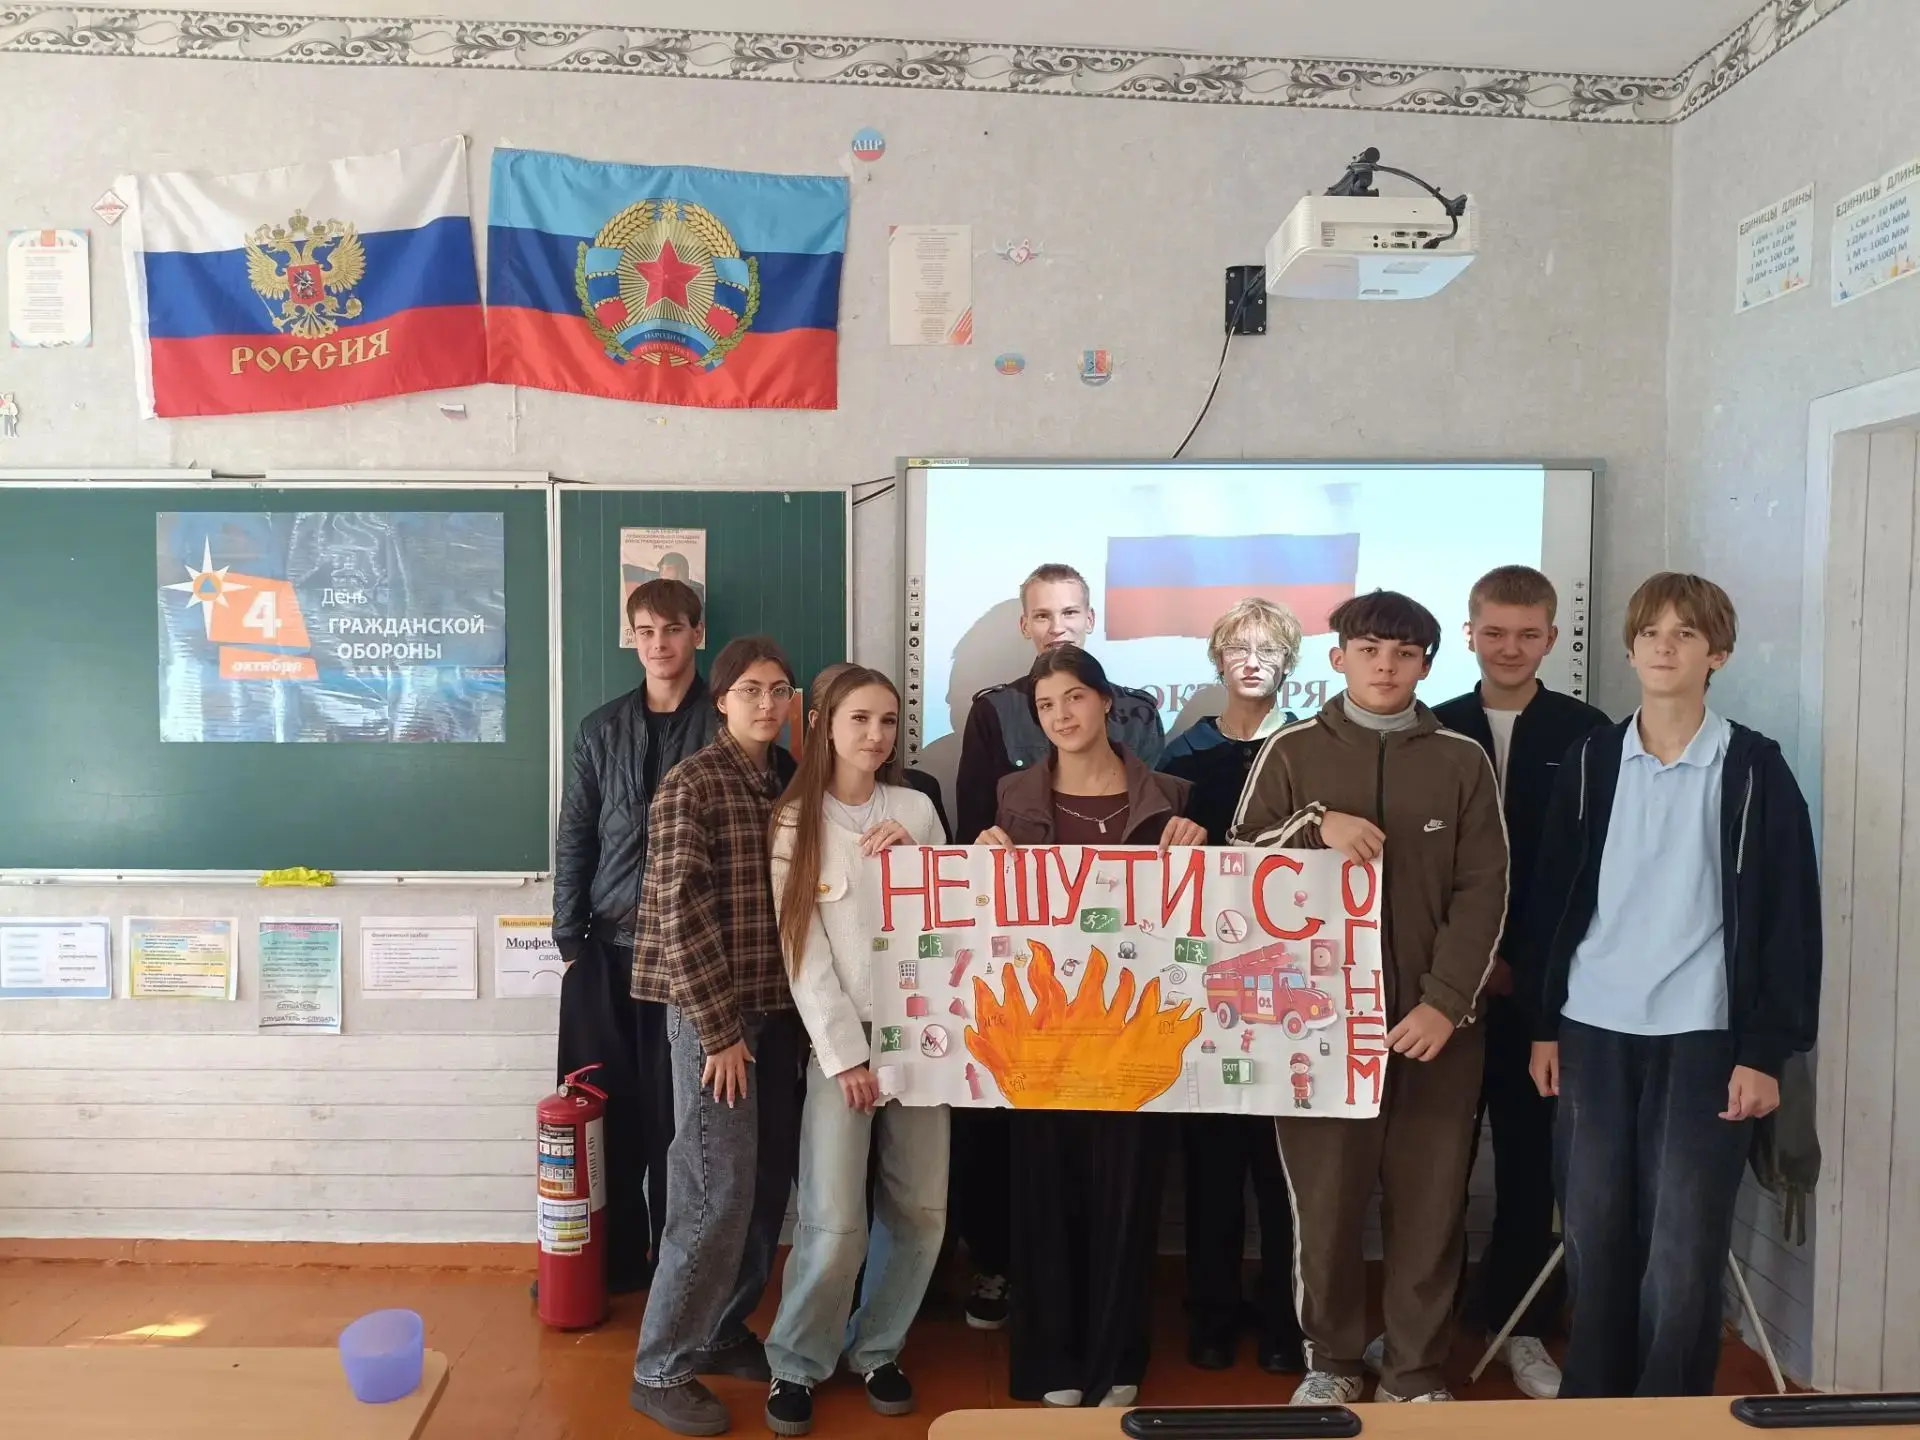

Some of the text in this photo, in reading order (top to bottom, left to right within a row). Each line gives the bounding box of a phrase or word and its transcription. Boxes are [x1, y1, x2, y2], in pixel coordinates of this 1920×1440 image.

[1836, 185, 1880, 217] ЕДИНИЦЫ
[1739, 189, 1812, 236] ЕДИНИЦЫ ДЛИНЫ
[230, 328, 391, 375] РОССИЯ
[321, 587, 368, 607] День
[242, 591, 282, 638] 4
[328, 614, 484, 636] ГРАЖДАНСКОЙ
[336, 642, 442, 659] ОБОРОНЫ
[231, 658, 304, 675] октября
[880, 846, 1326, 941] НЕ ШУТИ С
[506, 937, 557, 950] Морфем
[1223, 1063, 1239, 1071] EXIT
[576, 1097, 588, 1107] 5
